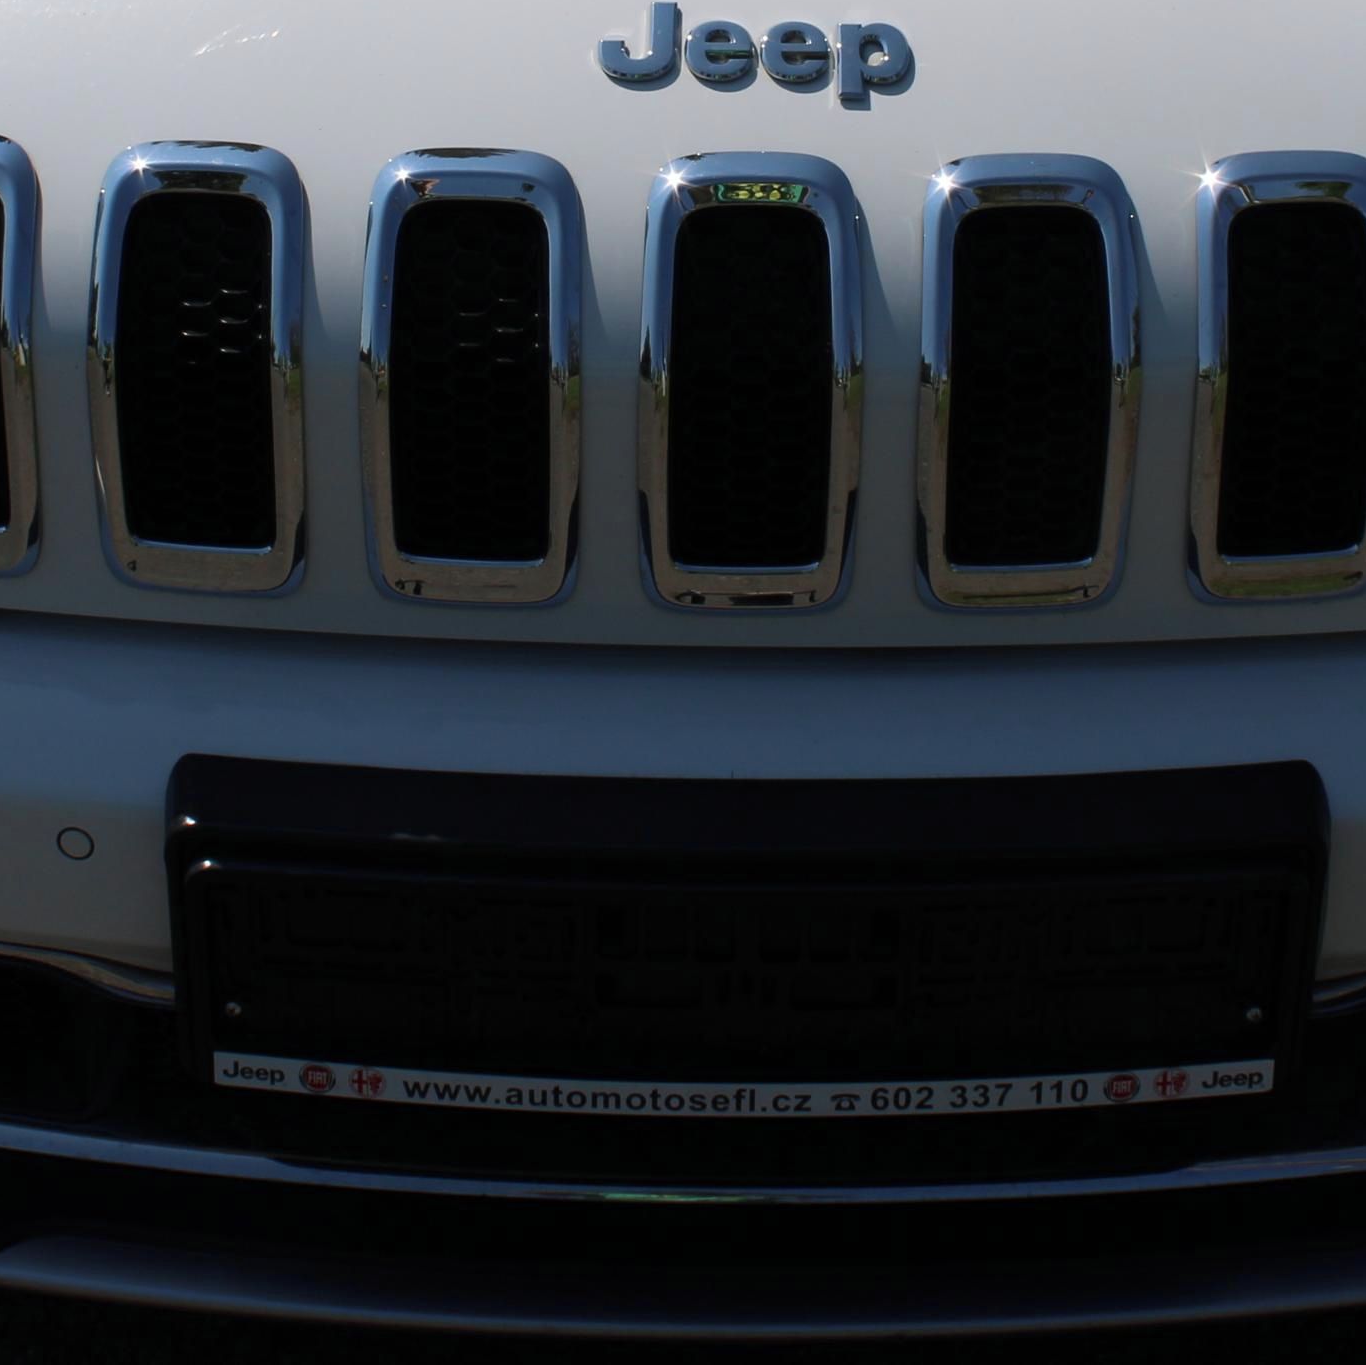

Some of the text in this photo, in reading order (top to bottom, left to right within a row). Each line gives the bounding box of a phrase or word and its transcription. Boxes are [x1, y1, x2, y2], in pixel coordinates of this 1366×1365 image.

[598, 1, 912, 101] Jeep
[222, 1061, 285, 1084] Jeep
[403, 1080, 812, 1112] www.automotosefl.cz
[871, 1087, 934, 1110] 602
[950, 1083, 1012, 1108] 337
[1030, 1079, 1088, 1104] 110
[1202, 1070, 1264, 1089] Jeep
